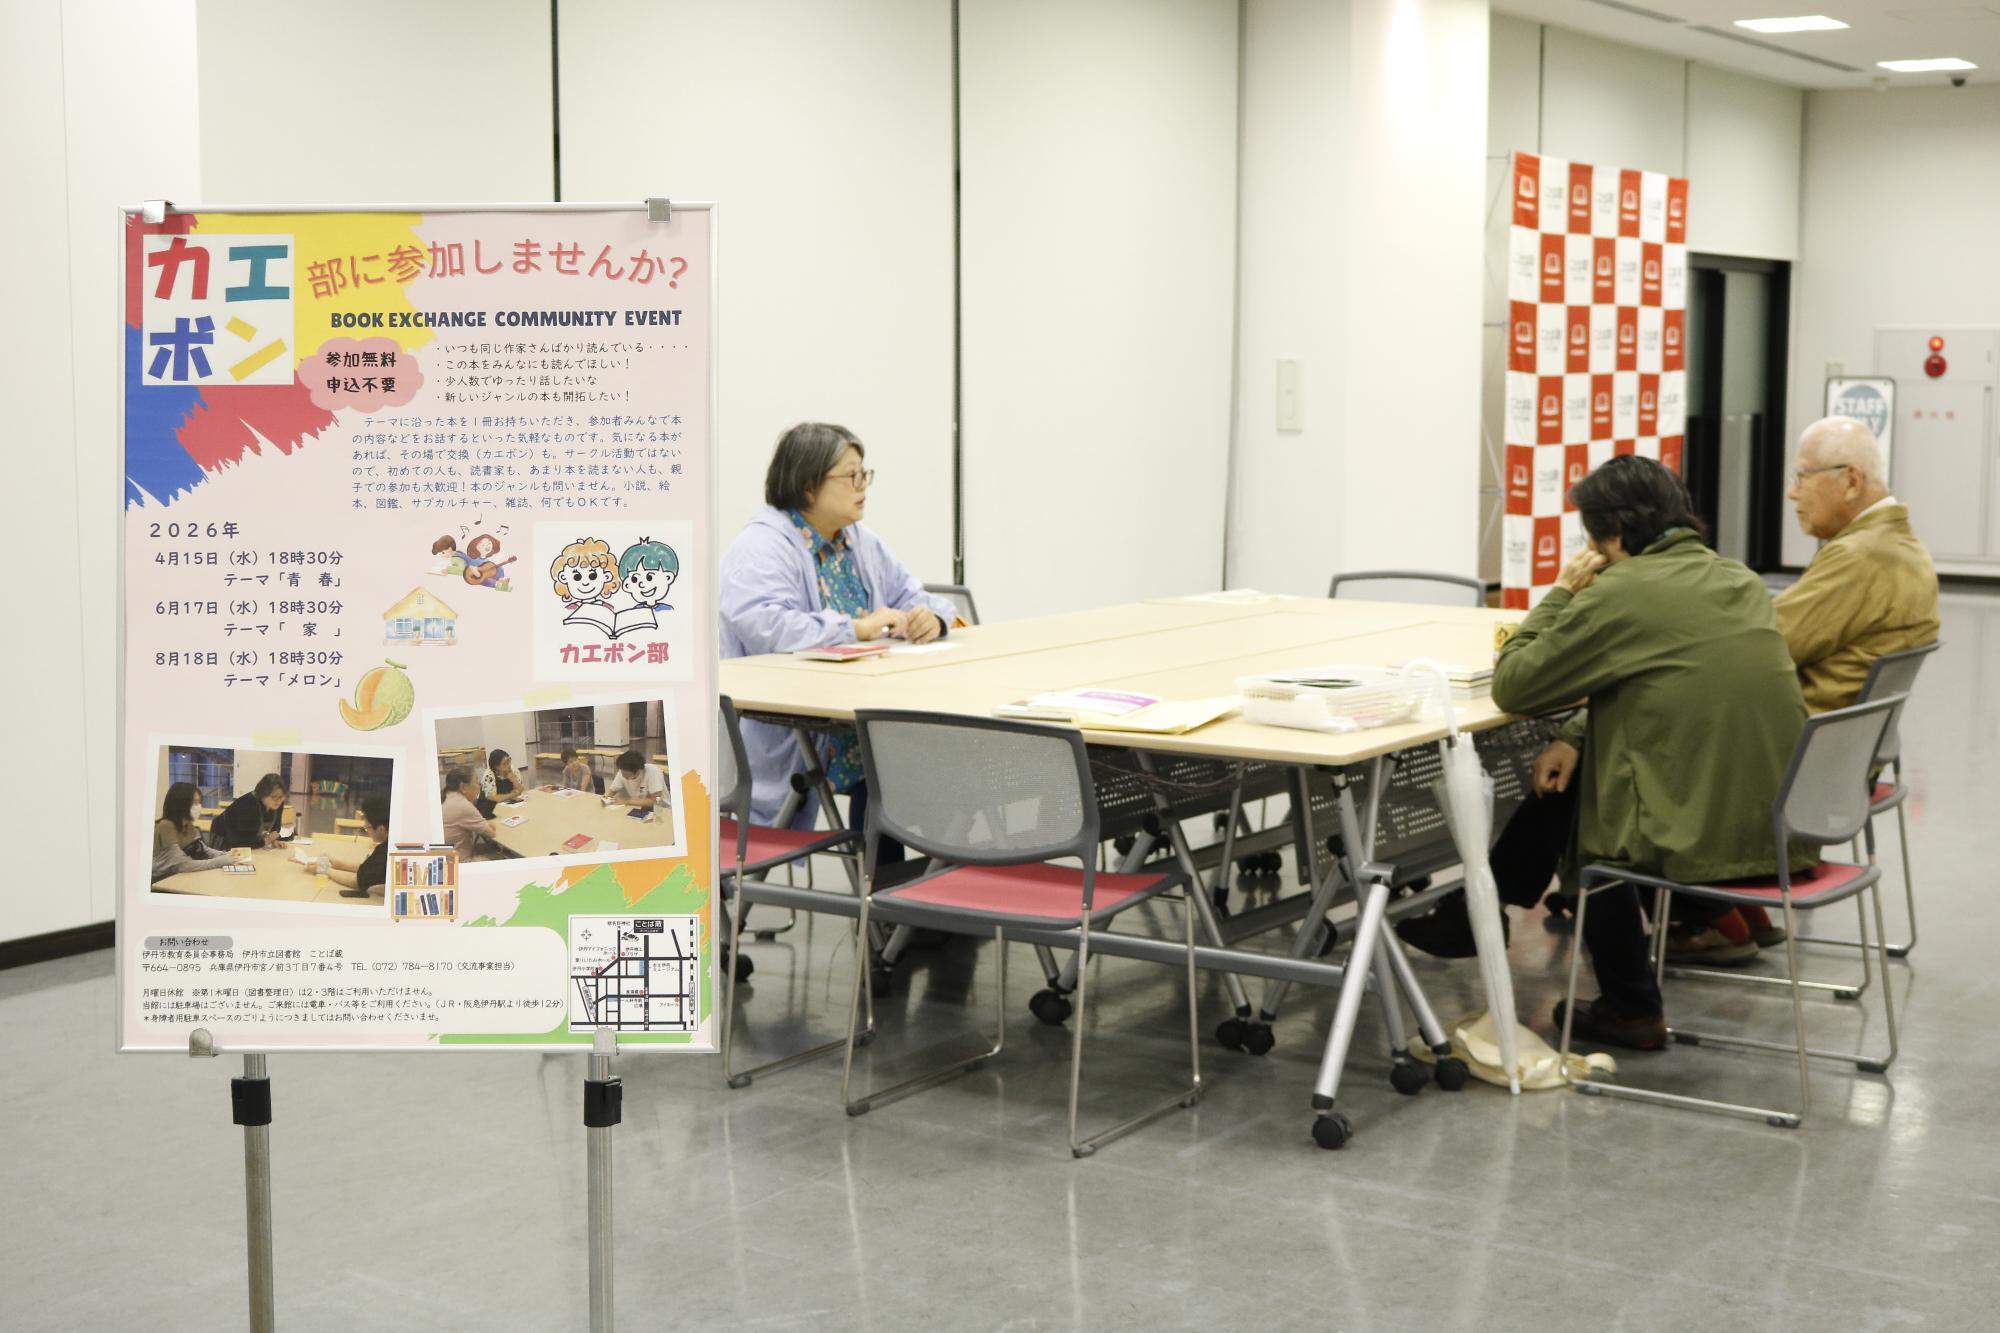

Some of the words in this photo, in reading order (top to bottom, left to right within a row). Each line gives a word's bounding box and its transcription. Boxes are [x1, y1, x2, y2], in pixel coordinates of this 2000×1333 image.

[306, 239, 689, 300] 部に参加しませんか?
[331, 312, 385, 328] BOOK
[388, 311, 487, 328] EXCHANGE
[494, 310, 617, 327] COMMUNITY
[624, 310, 683, 326] EVENT
[326, 351, 397, 368] 参加無料
[326, 377, 396, 393] 申込不要
[1836, 397, 1885, 415] STAFF
[150, 521, 239, 539] 2026年
[559, 642, 670, 664] カエボン部
[224, 672, 341, 688] テーマ「メロン」
[159, 937, 209, 947] お問い合わせ
[142, 949, 234, 960] 伊丹市教育委員会事務局
[242, 949, 301, 959] 伊丹市立図書館
[310, 949, 344, 958] ことば蔵
[142, 988, 185, 997] 月曜日休館
